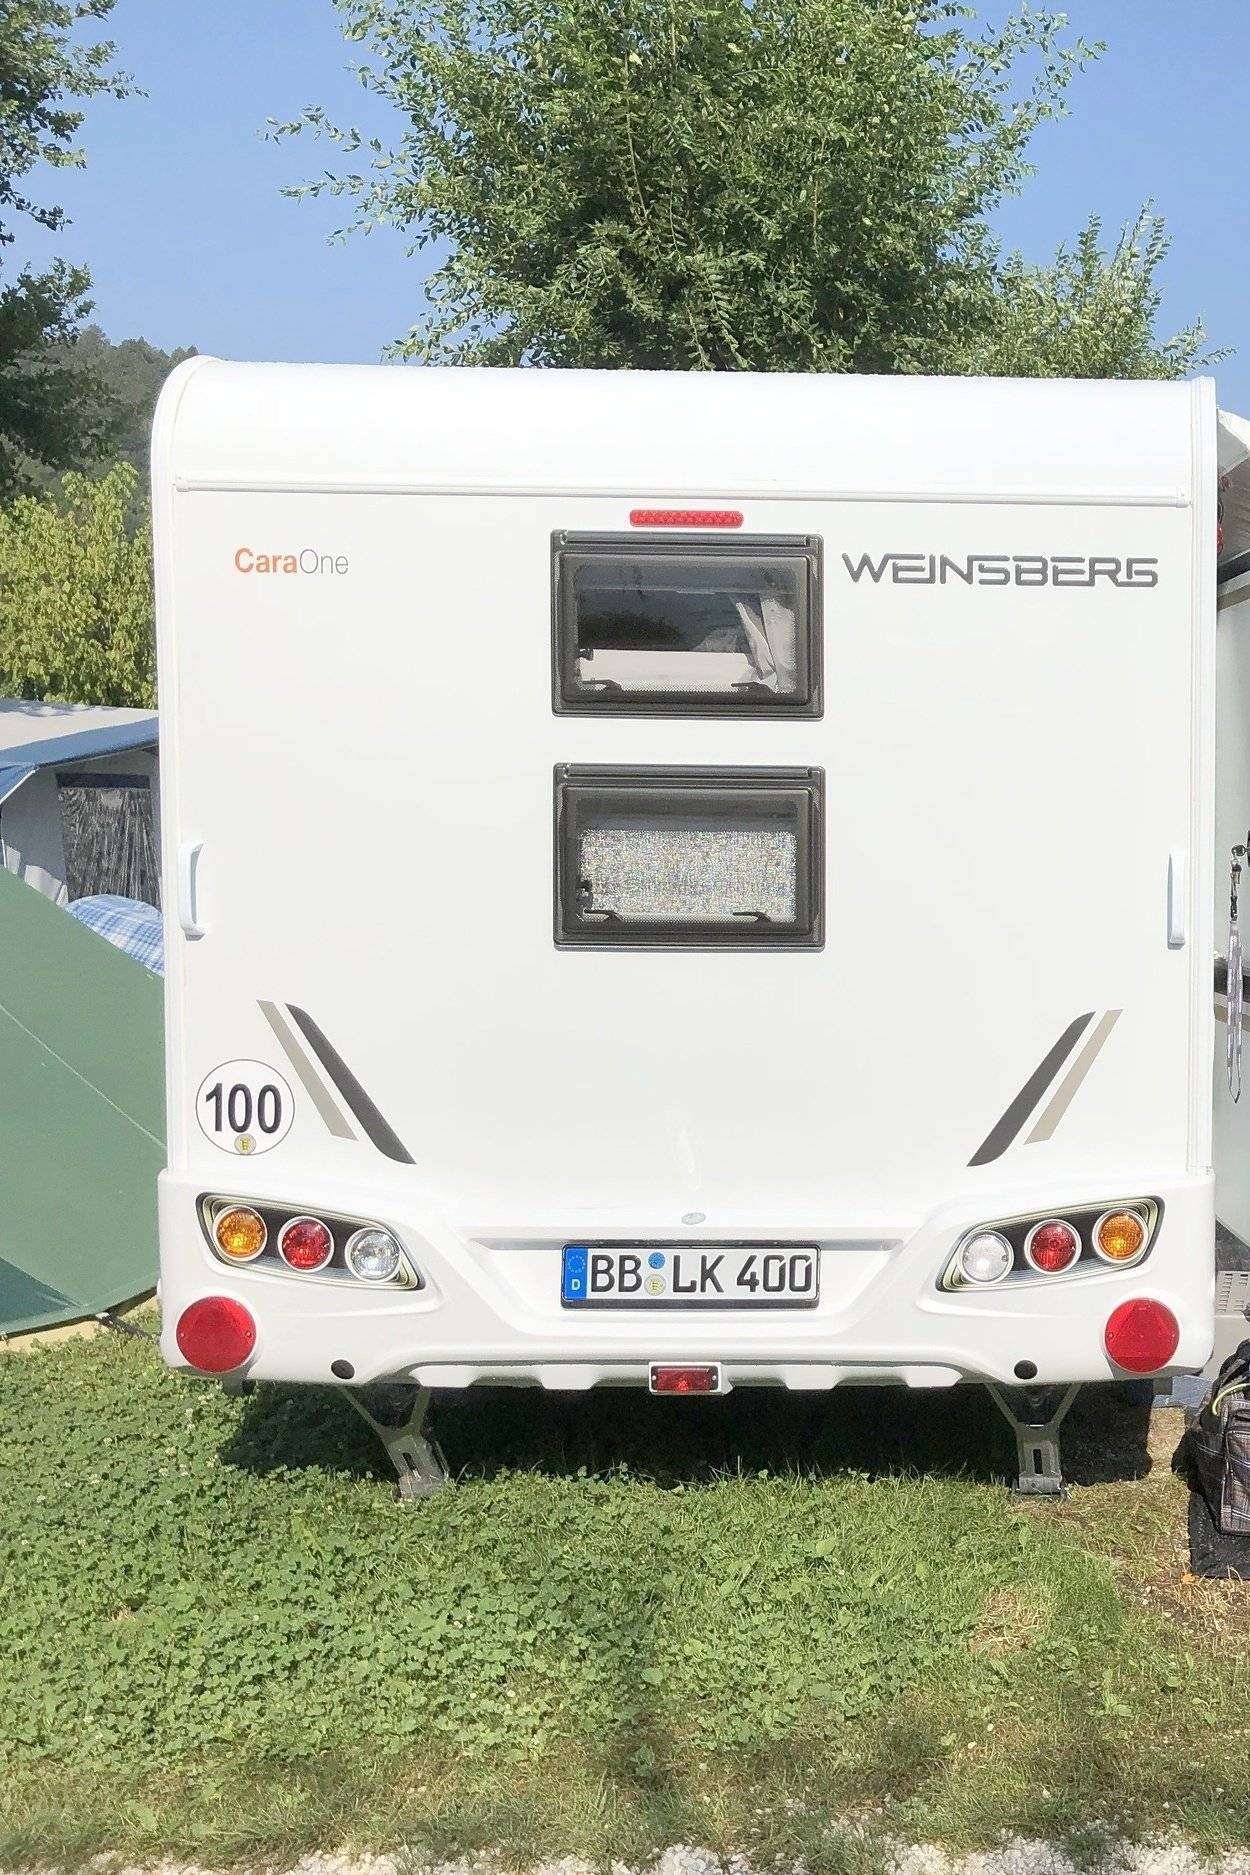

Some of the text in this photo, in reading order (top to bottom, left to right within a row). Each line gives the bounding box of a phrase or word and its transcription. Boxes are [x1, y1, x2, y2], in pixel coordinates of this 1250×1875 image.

[234, 547, 349, 575] CaraOne
[842, 552, 1158, 588] WEINSBERG
[205, 1082, 282, 1134] 100
[571, 1278, 581, 1291] D
[590, 1254, 811, 1293] BB LK 400
